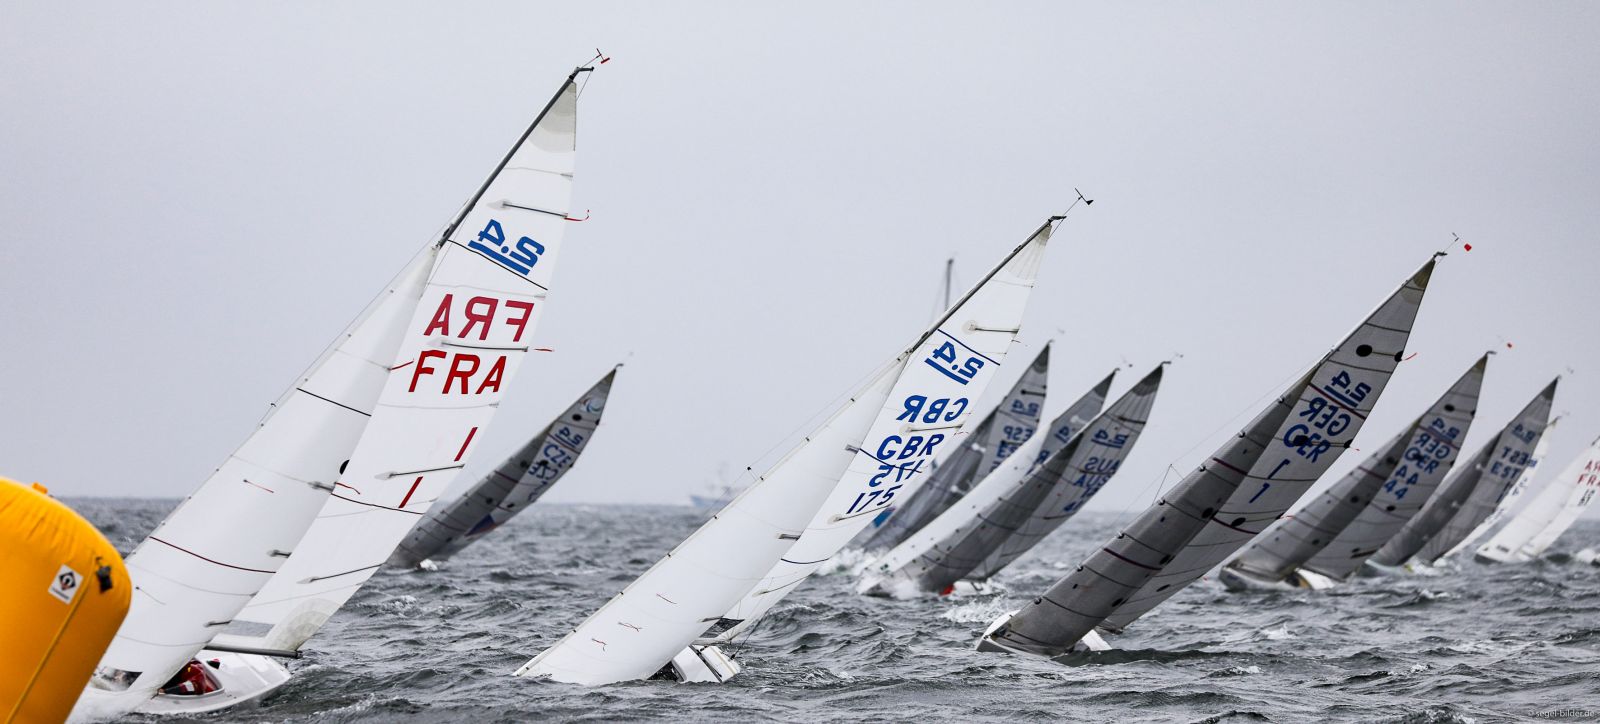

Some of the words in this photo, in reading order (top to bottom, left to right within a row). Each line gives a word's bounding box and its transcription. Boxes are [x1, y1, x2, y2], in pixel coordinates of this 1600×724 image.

[408, 350, 507, 394] FRA
[543, 444, 571, 467] CZE
[876, 433, 944, 460] GBR
[1283, 424, 1331, 463] GER
[1405, 447, 1439, 474] GER
[1490, 461, 1521, 479] EST
[846, 485, 902, 514] 175
[1384, 480, 1408, 499] 44
